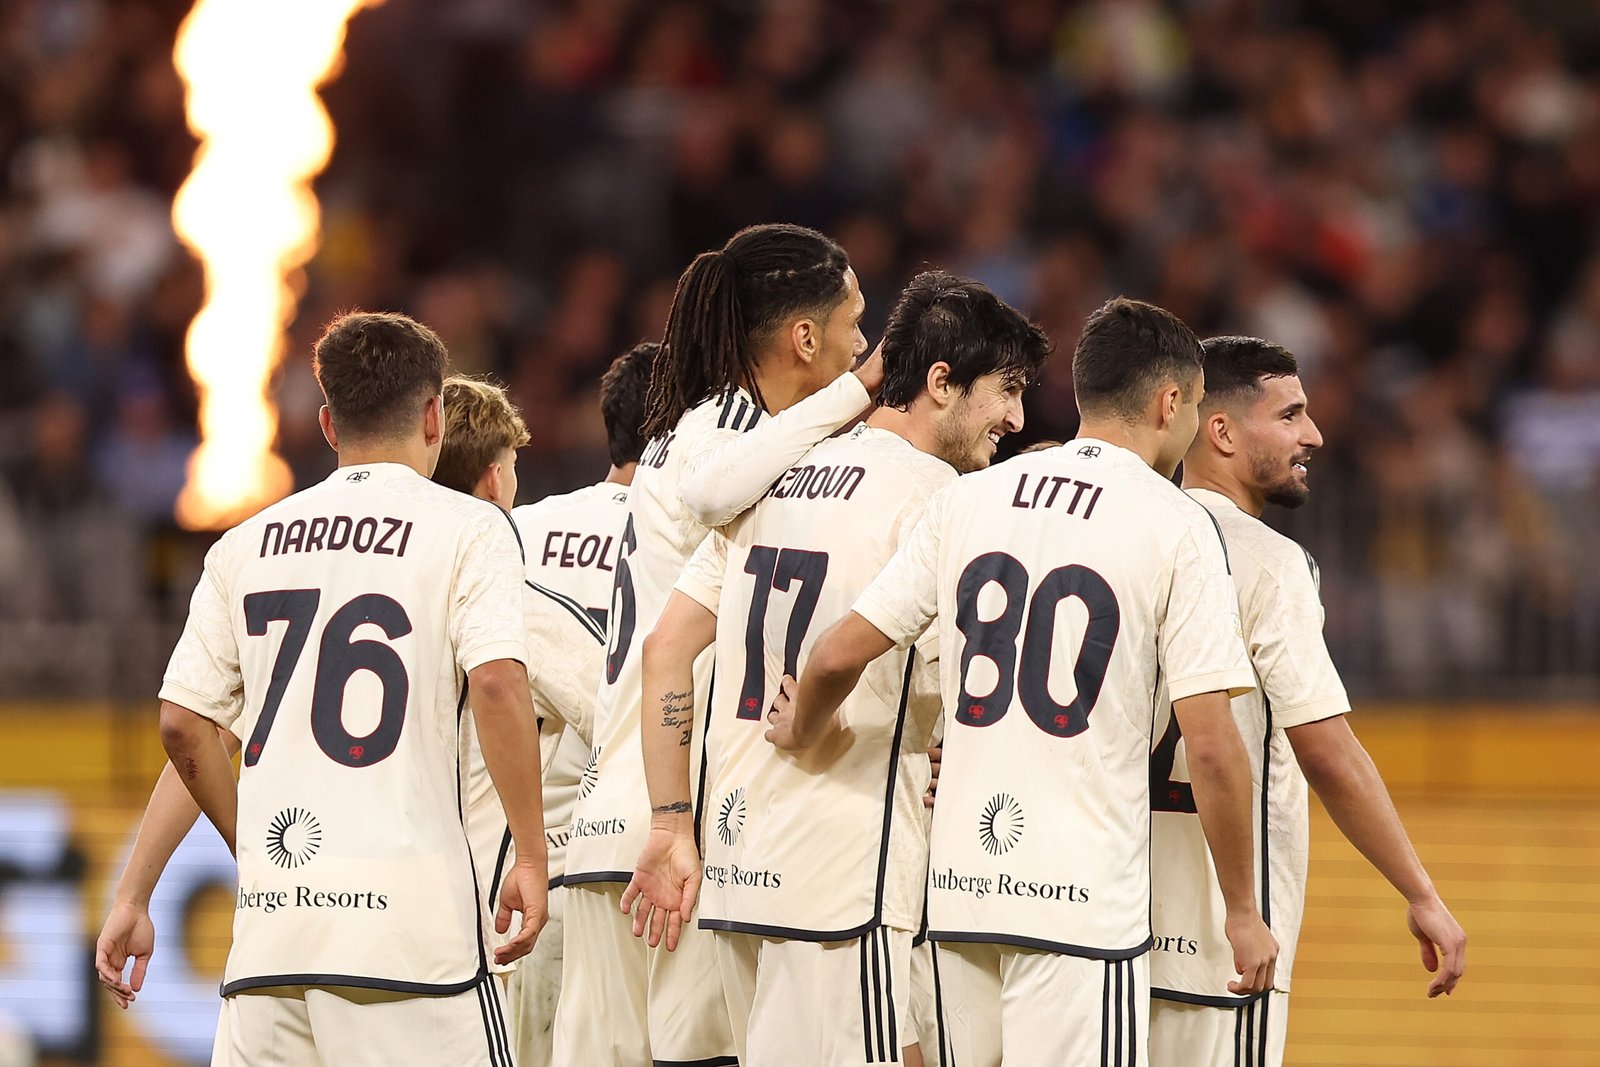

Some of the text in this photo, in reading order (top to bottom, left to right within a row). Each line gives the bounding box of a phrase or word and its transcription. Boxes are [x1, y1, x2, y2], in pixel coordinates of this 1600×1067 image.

[1012, 473, 1103, 520] LITTI
[259, 515, 413, 558] NARDOZI
[736, 545, 829, 721] 17
[955, 551, 1120, 738] 80
[243, 588, 412, 768] 76
[575, 817, 626, 838] Resorts
[237, 886, 388, 913] berge Resorts
[997, 873, 1090, 903] Resorts
